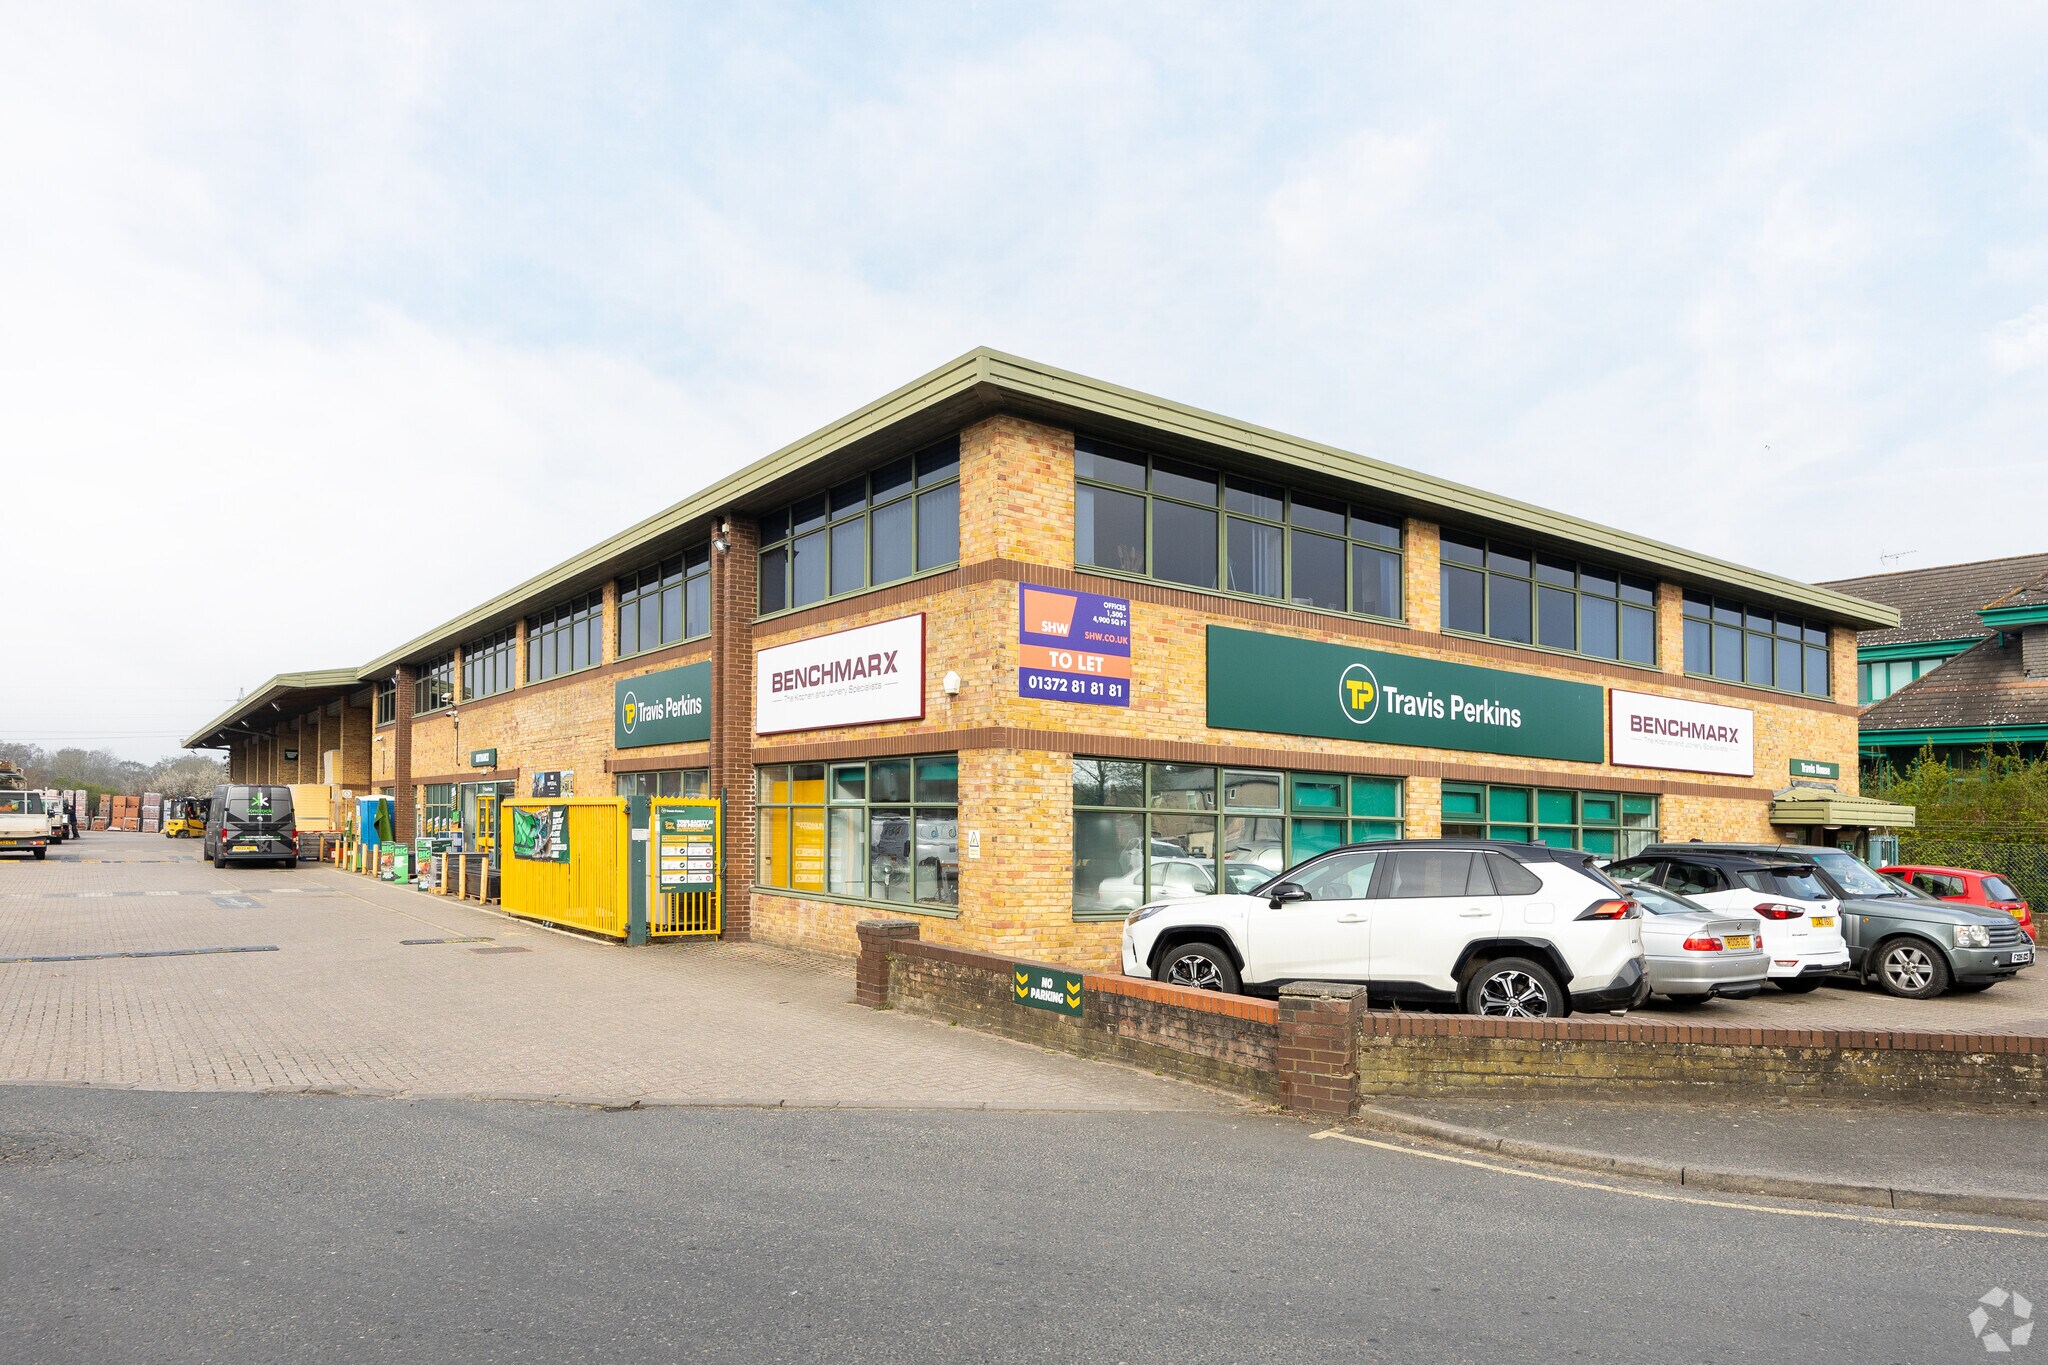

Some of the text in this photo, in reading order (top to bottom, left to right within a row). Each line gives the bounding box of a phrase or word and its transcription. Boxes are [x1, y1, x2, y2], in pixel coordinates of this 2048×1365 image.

[1103, 602, 1127, 611] OFFICES
[1106, 610, 1123, 618] 1,500
[1041, 620, 1069, 635] SHW
[1093, 616, 1110, 624] 4,900
[1084, 631, 1128, 645] SHW.CO.UK
[1049, 651, 1104, 673] TO LET
[772, 650, 898, 693] BENCHMARX
[1028, 675, 1122, 698] 01372 81 81 81
[638, 694, 702, 722] Travis Perkins
[1382, 685, 1522, 728] Travis Perkins
[1630, 714, 1739, 744] BENCHMARX
[1801, 762, 1830, 775] Travis House
[1041, 976, 1053, 989] NO
[1030, 987, 1064, 1004] PARKING
